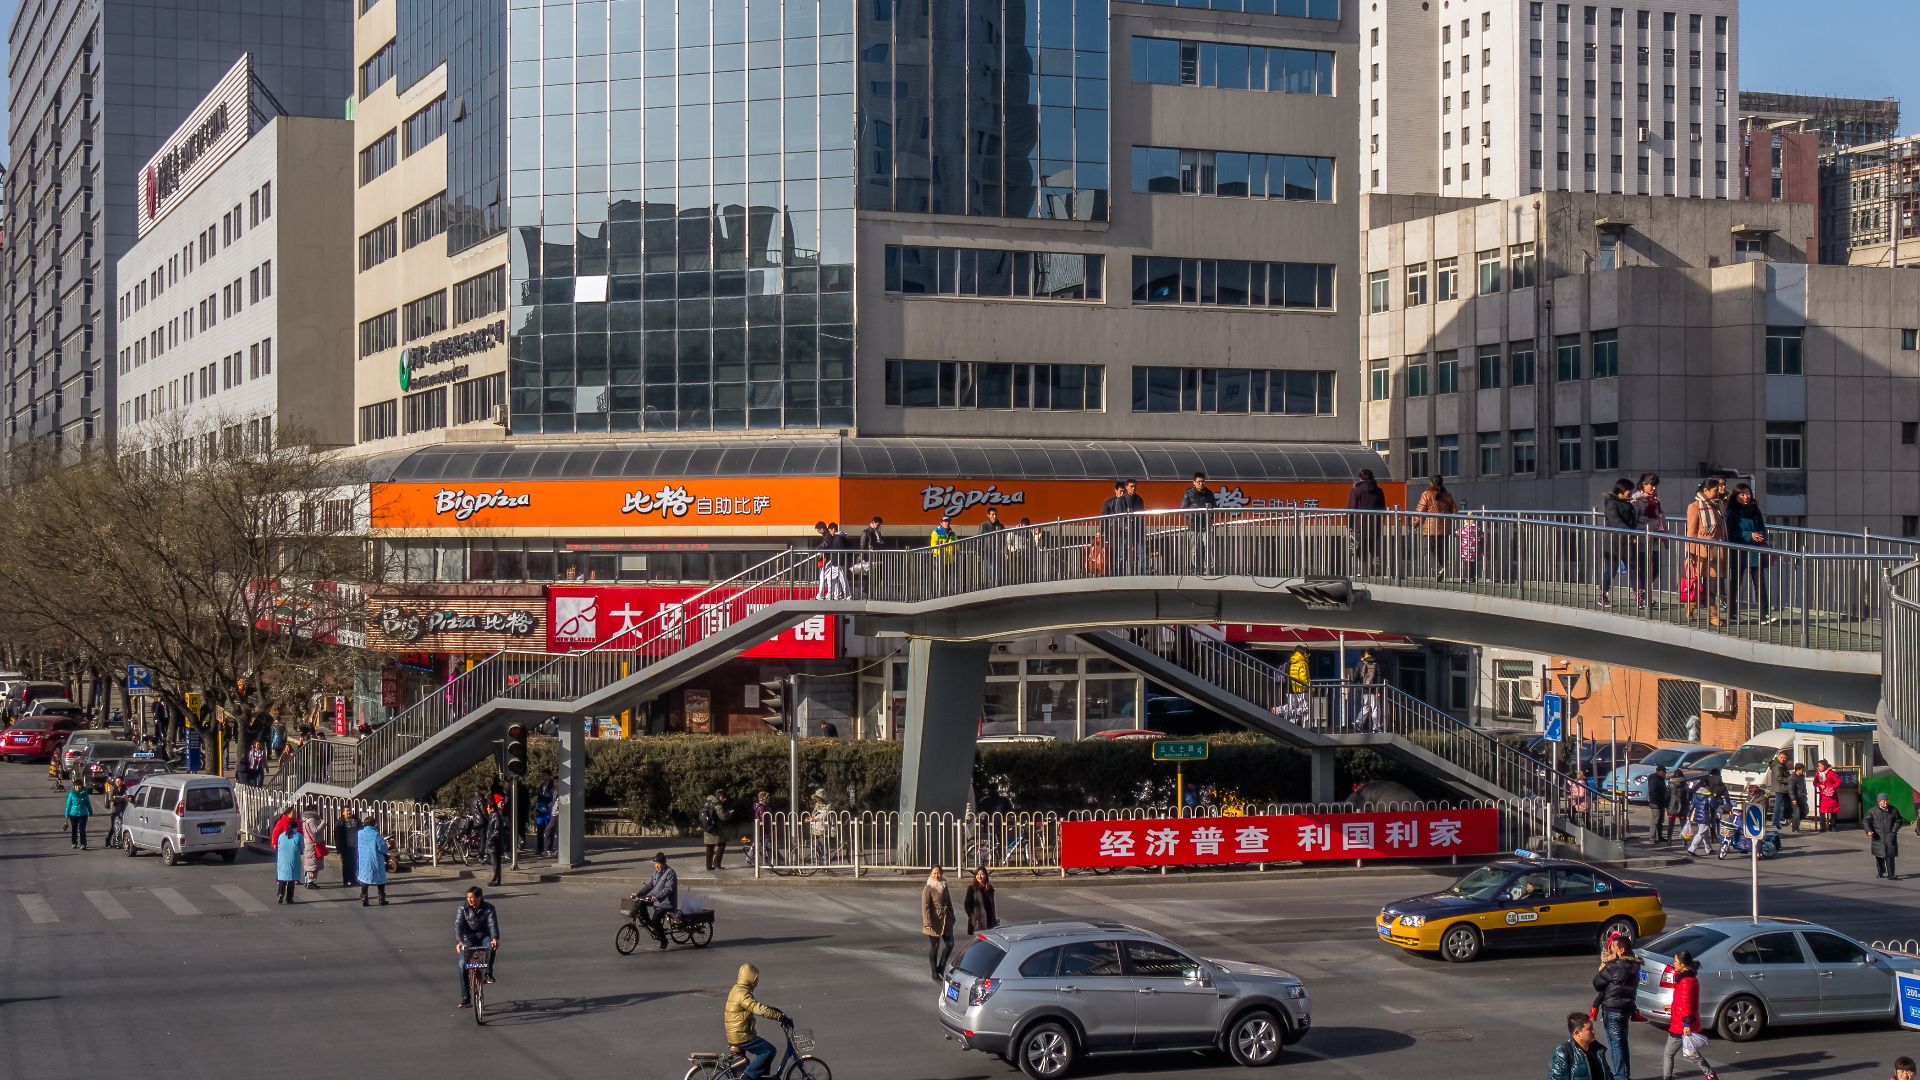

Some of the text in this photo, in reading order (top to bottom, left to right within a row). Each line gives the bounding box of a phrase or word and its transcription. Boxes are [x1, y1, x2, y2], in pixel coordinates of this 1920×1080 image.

[621, 484, 771, 519] 比格 自助比萨
[427, 610, 476, 633] Pizza
[1099, 817, 1463, 858] 经济普查 利国利家
